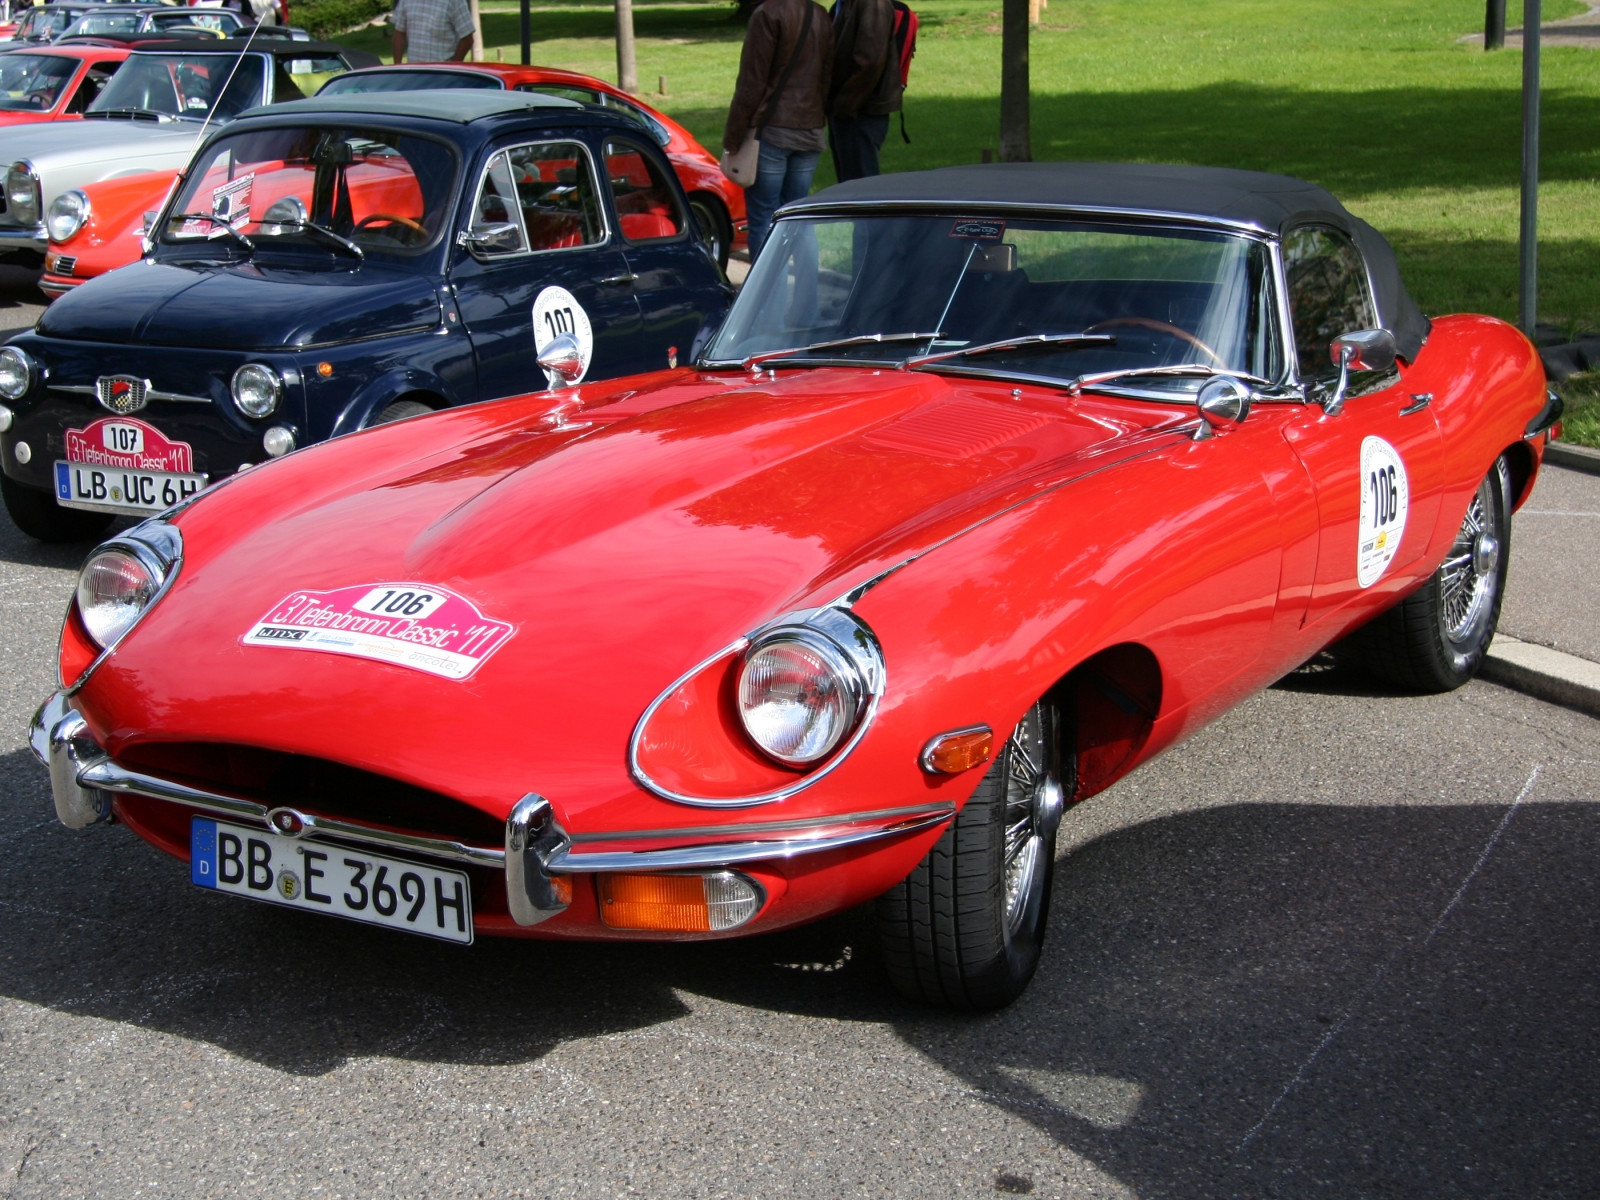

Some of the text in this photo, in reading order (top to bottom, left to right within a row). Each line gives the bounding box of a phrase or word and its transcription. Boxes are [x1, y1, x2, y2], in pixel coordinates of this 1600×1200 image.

[110, 427, 138, 451] 107
[76, 469, 108, 500] LB
[123, 474, 157, 505] UC
[1370, 464, 1397, 529] 106
[370, 590, 433, 616] 106
[386, 618, 460, 648] Classic
[199, 860, 210, 875] D
[218, 831, 466, 933] BB E 369H
